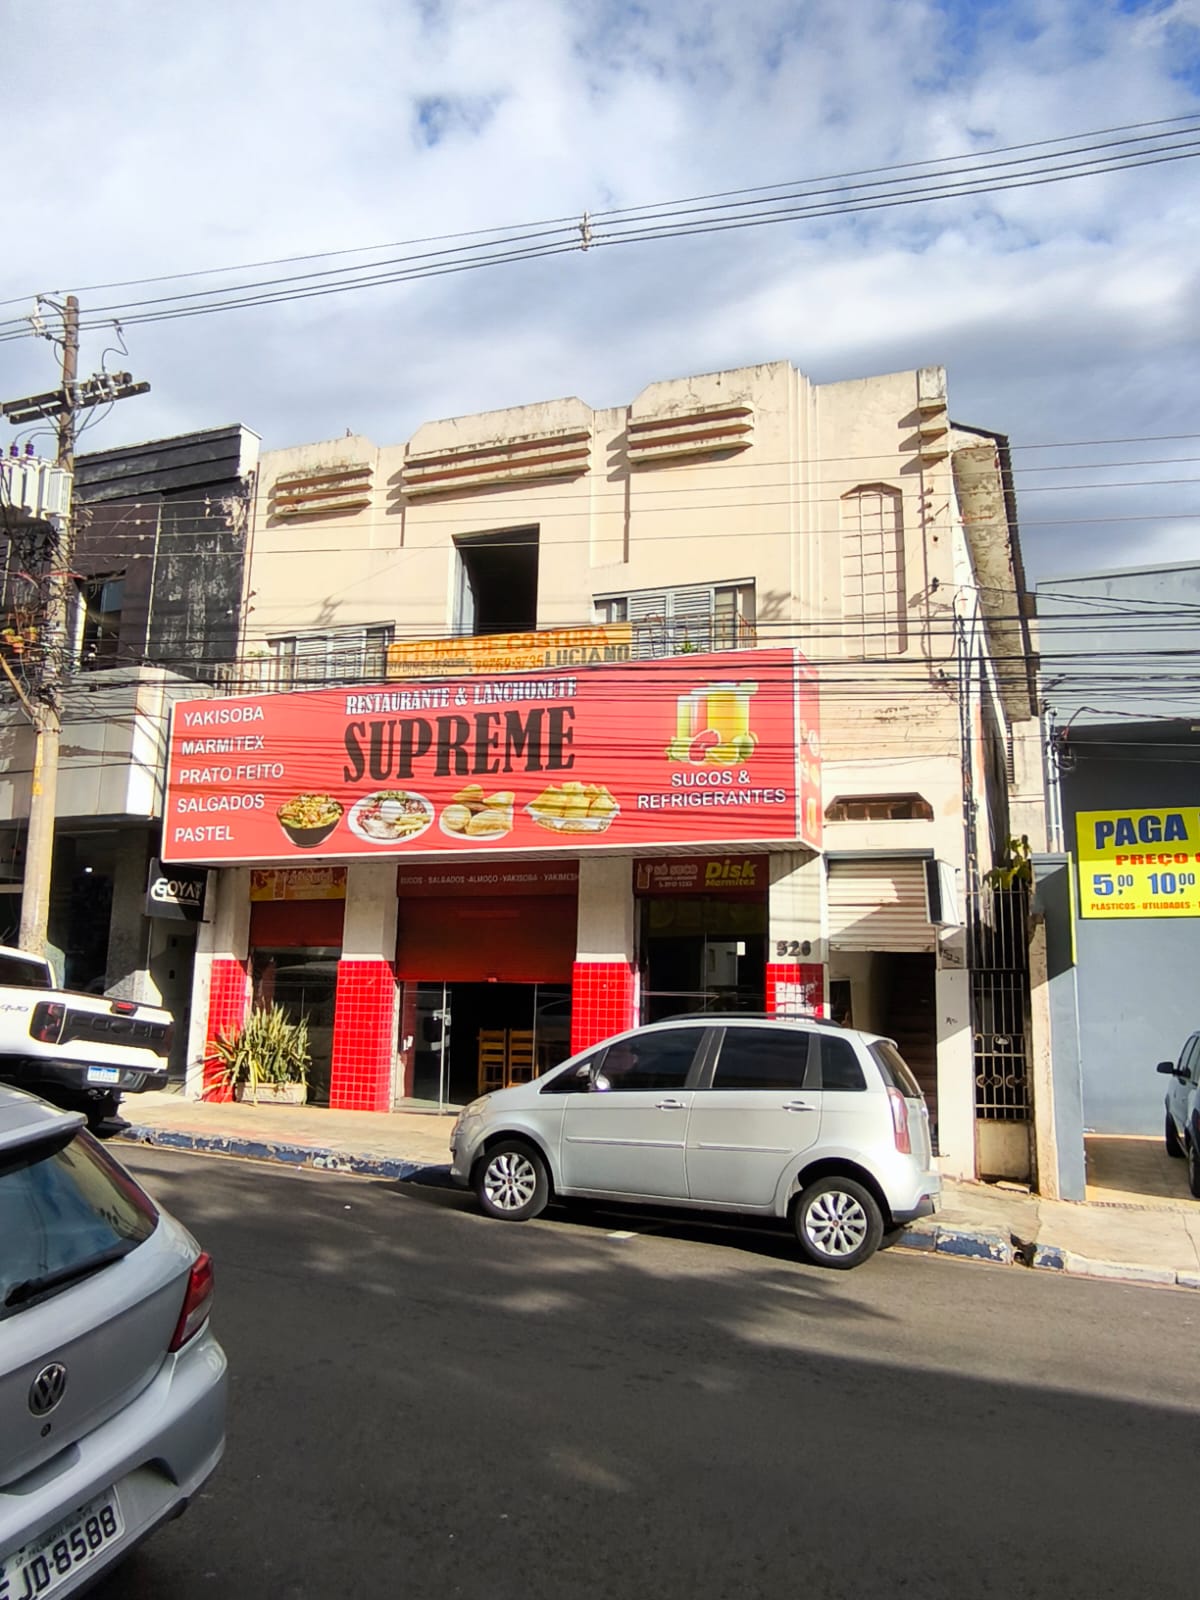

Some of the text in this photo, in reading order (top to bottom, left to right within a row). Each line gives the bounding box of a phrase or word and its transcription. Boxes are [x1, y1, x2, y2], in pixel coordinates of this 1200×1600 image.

[545, 645, 630, 667] LUCIANO
[346, 677, 577, 715] RESTAURANTE & LANCHONETE
[184, 706, 264, 727] YAKISOBA
[182, 735, 265, 756] MARMITEX
[343, 706, 576, 783] SUPREME
[179, 763, 285, 784] PRATO FEITO
[671, 769, 751, 787] SUCOS &
[177, 793, 265, 813] SALGADOS
[637, 789, 786, 809] REFRIGERANTES
[174, 825, 234, 843] PASTEL
[1094, 813, 1189, 850] PAGA
[705, 859, 758, 878] Disk
[1115, 852, 1189, 867] PREÇO
[1142, 901, 1191, 910] UTILIDADES
